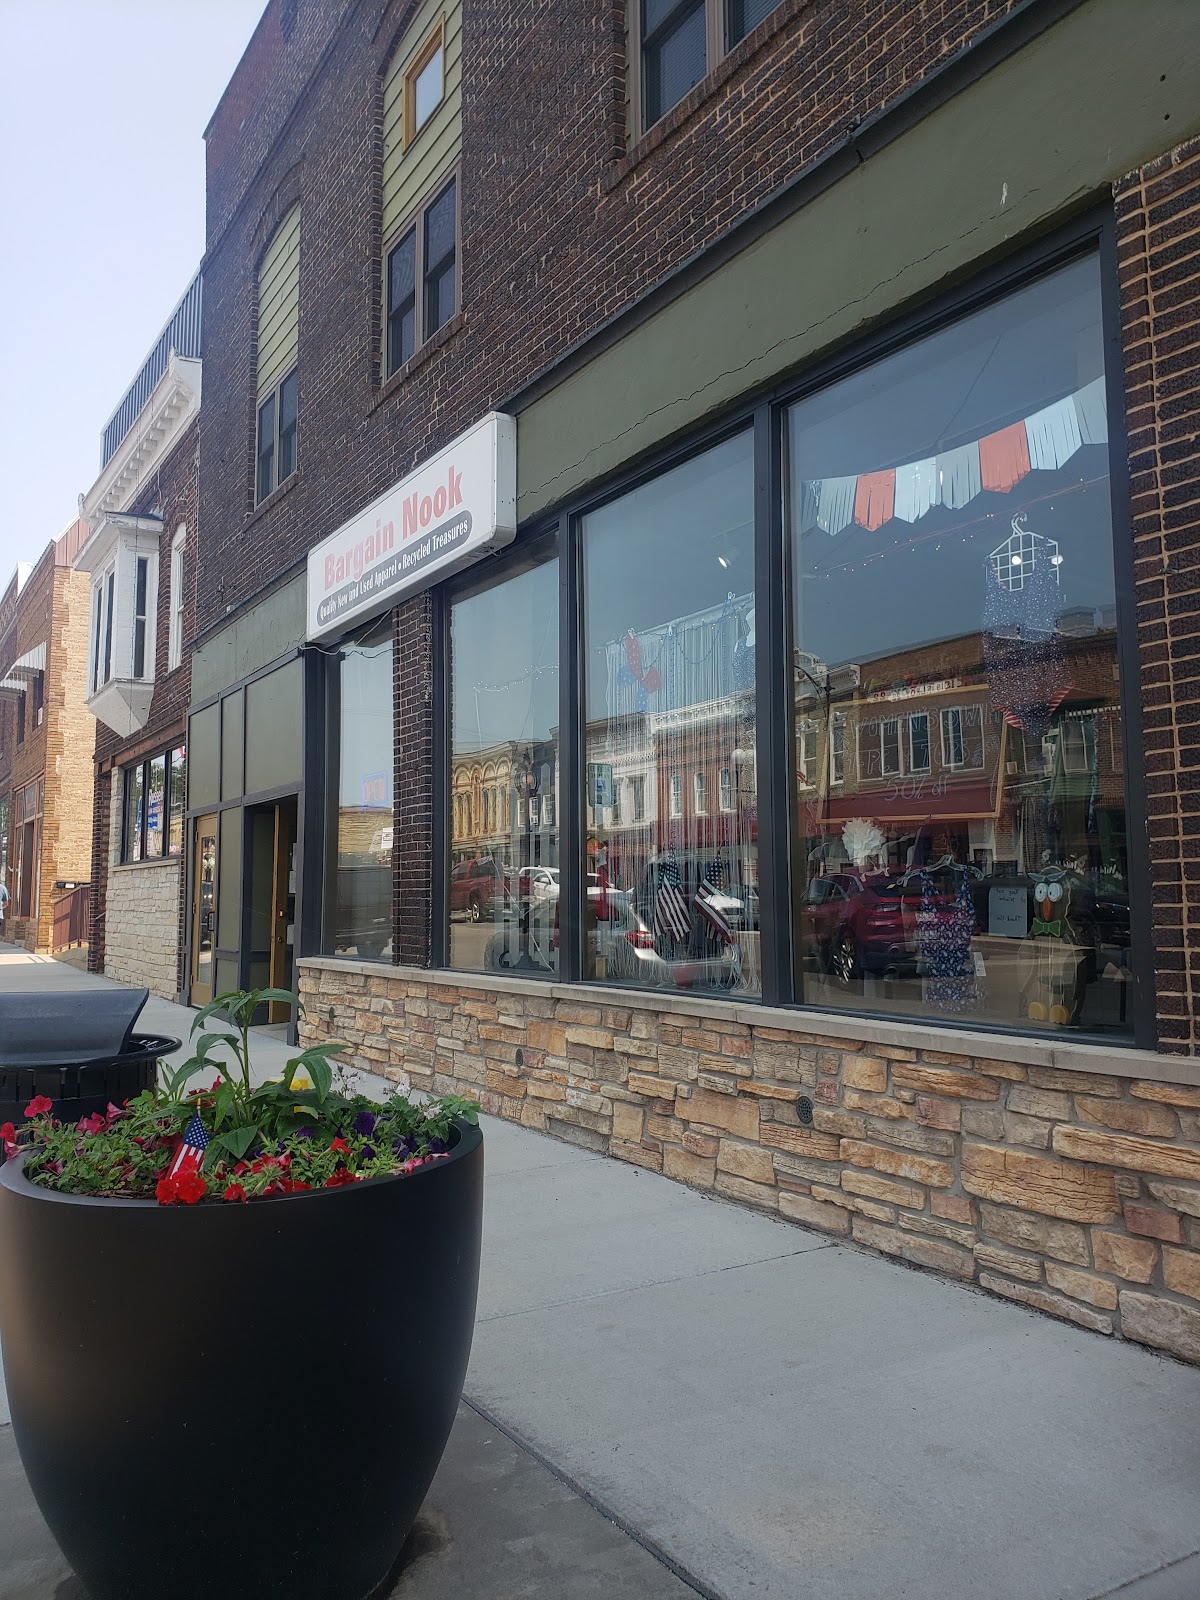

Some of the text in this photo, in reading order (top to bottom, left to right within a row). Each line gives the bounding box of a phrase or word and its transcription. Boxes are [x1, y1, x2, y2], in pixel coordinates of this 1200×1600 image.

[320, 519, 468, 621] Quality New and Used Apparel Recycled Treasures
[324, 464, 463, 592] Bargain Nook
[884, 775, 925, 801] 50%
